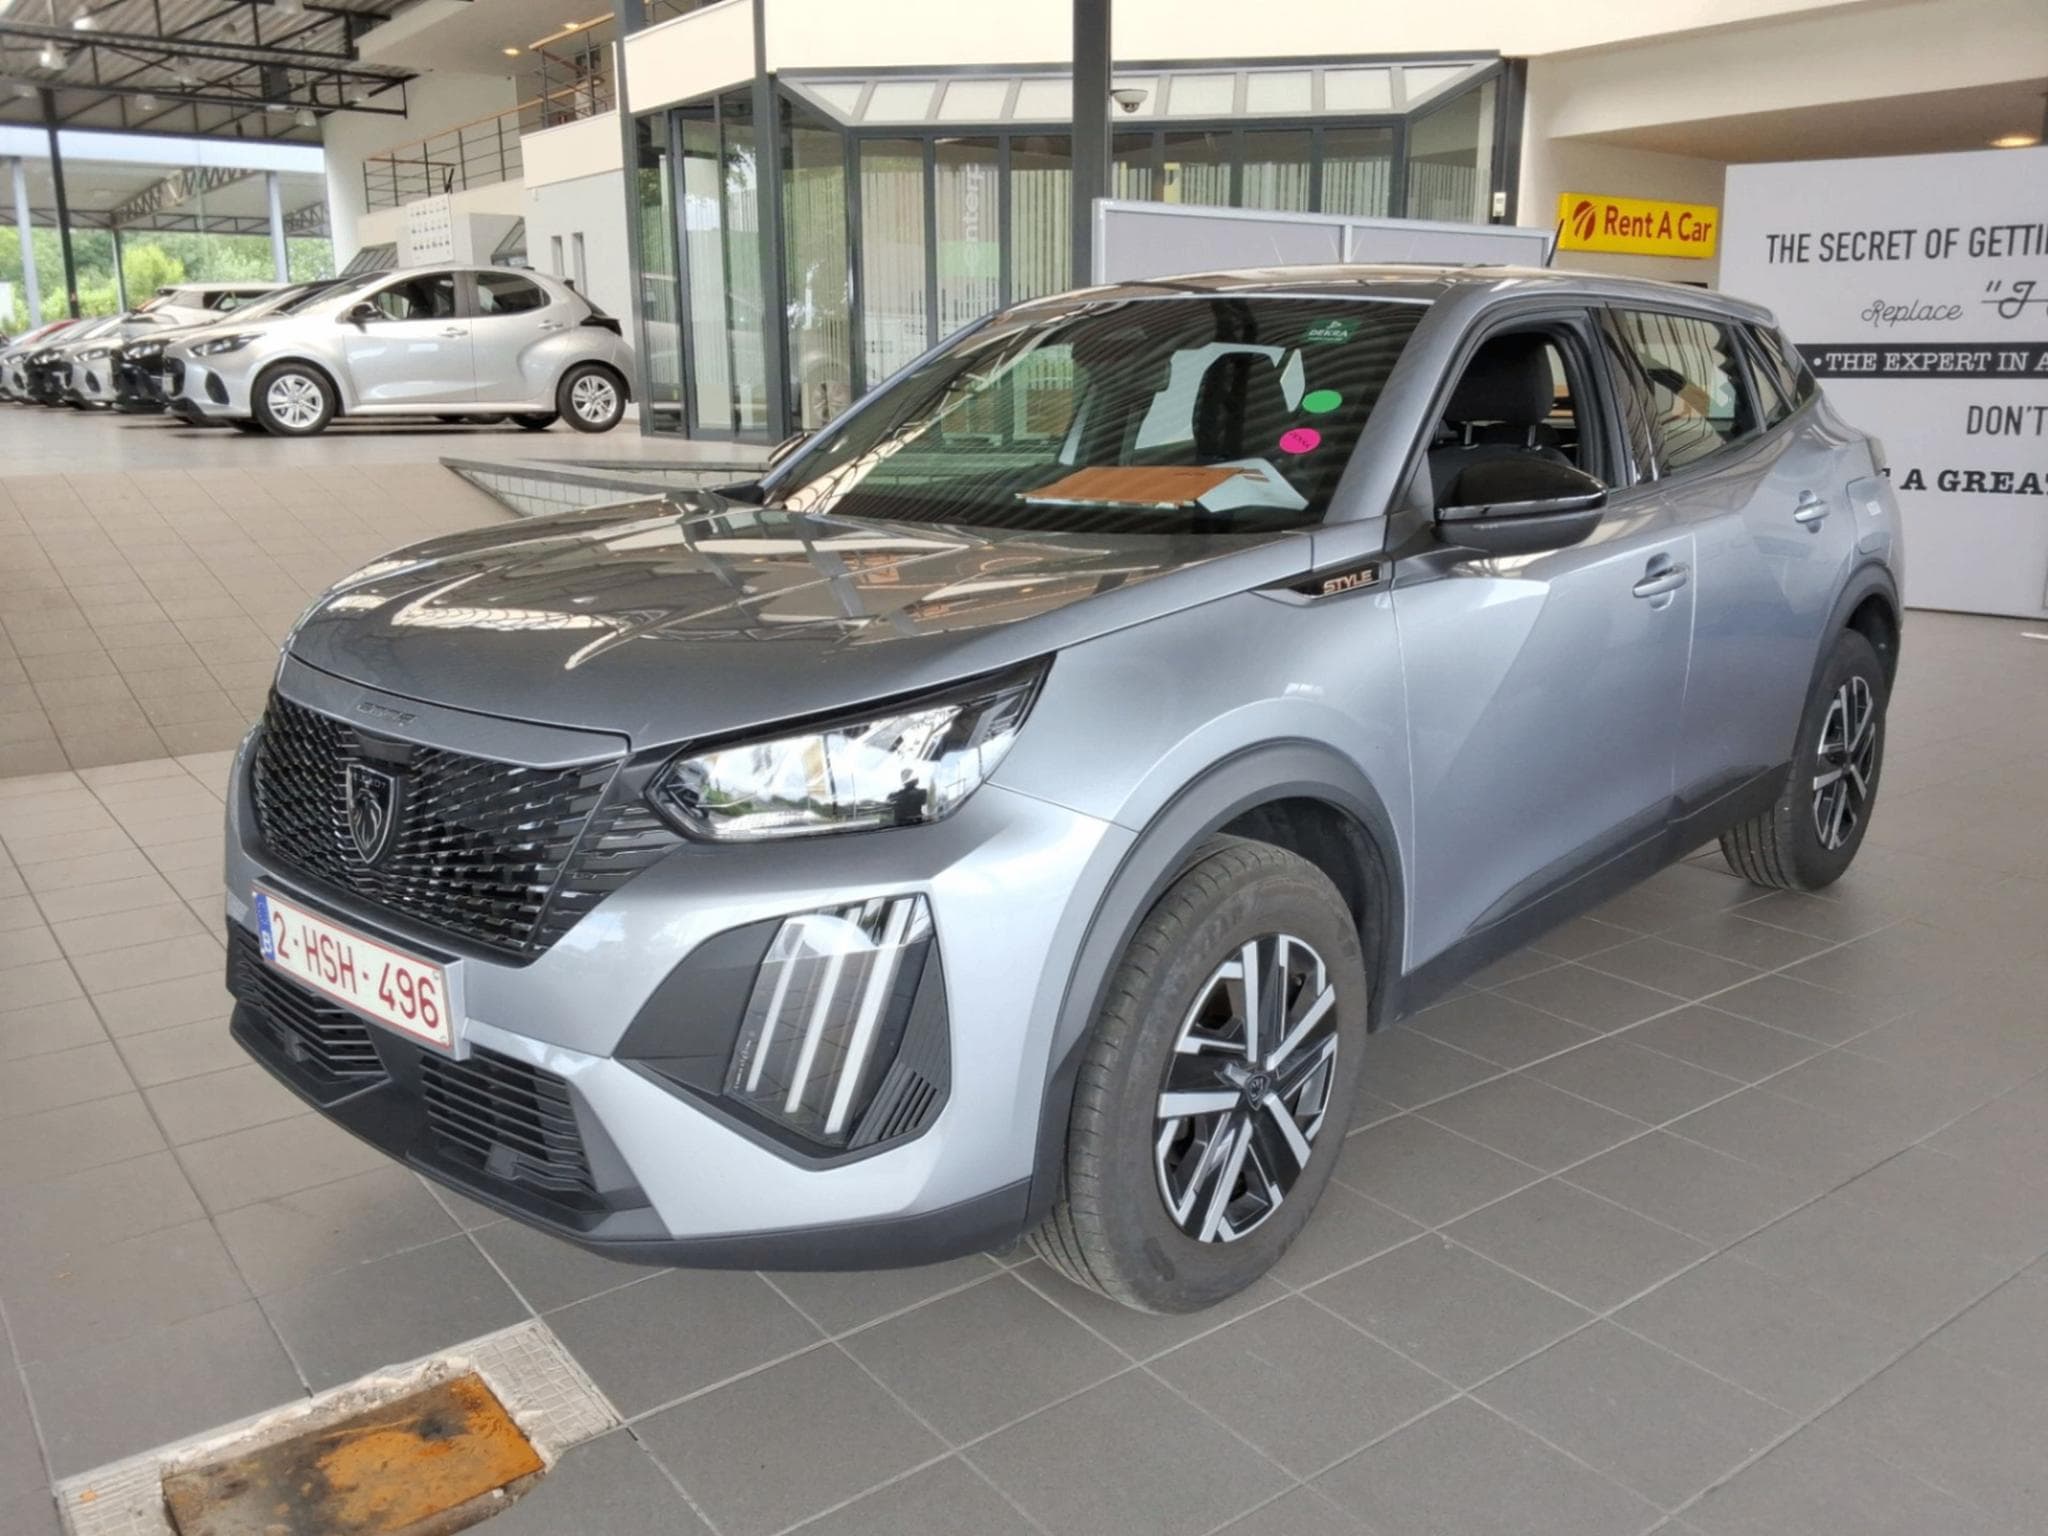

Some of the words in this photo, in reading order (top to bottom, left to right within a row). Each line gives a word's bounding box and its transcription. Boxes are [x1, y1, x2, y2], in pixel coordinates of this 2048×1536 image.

[1604, 204, 1654, 238] Rent
[1657, 210, 1672, 240] A
[1677, 211, 1712, 243] Car
[1765, 232, 1812, 264] THE
[1818, 229, 1918, 263] SECRET
[1924, 227, 1961, 260] OF
[1967, 223, 2048, 259] GETTI
[1860, 298, 1964, 329] Replace
[1825, 351, 1878, 373] THE
[1882, 351, 1992, 373] EXPERT
[1996, 351, 2030, 372] IN
[1965, 404, 2048, 436] DON'T
[1899, 467, 1927, 492] A
[1937, 468, 2048, 496] GREA
[1323, 569, 1373, 594] STYLE
[273, 910, 440, 1029] 2-HSH-496
